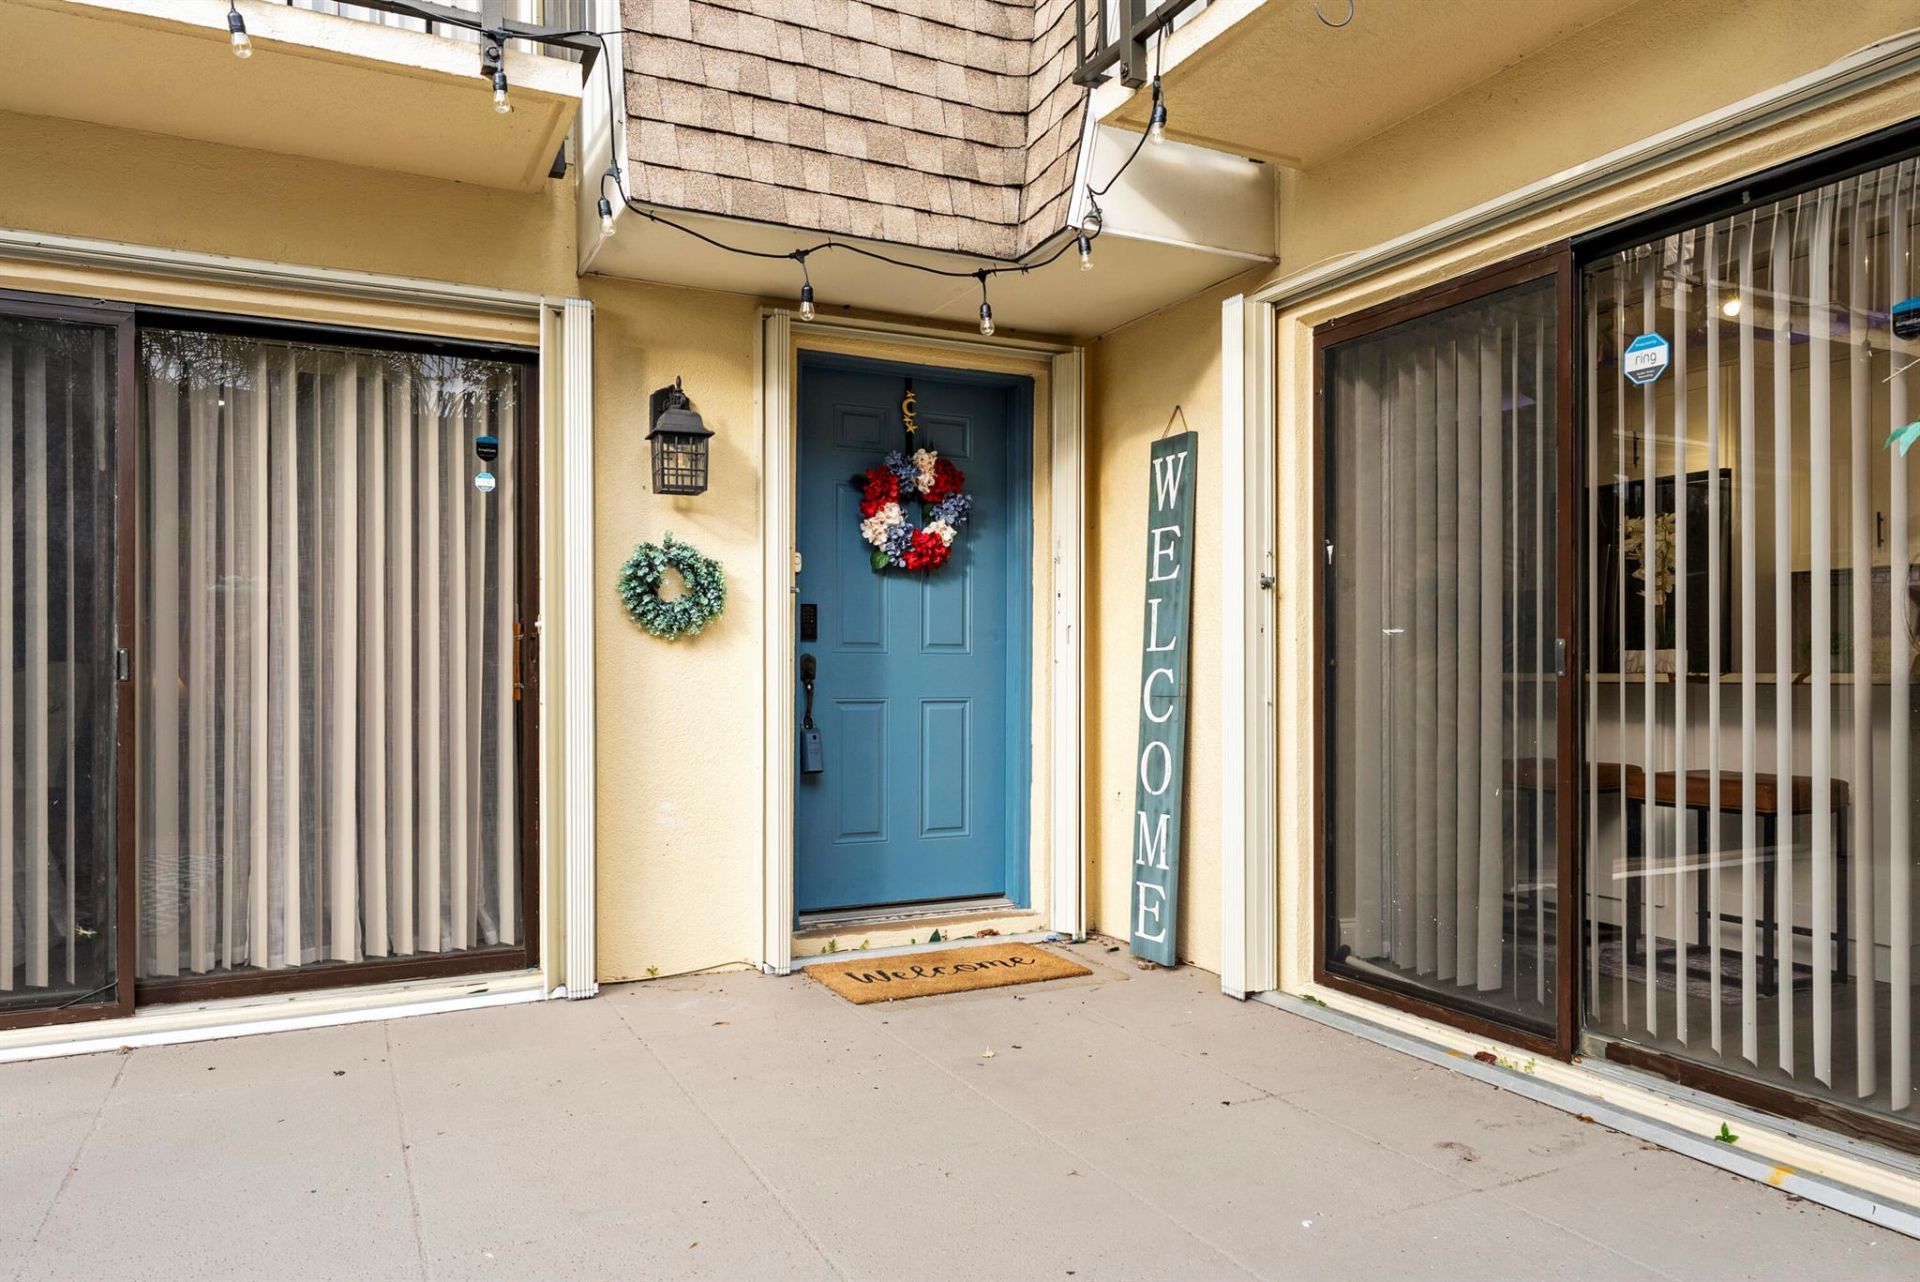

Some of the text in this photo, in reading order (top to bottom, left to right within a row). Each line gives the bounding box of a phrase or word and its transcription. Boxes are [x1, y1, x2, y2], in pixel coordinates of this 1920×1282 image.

[1635, 352, 1656, 365] ring
[1135, 451, 1187, 942] WELCOME
[844, 954, 1036, 984] Welcome
